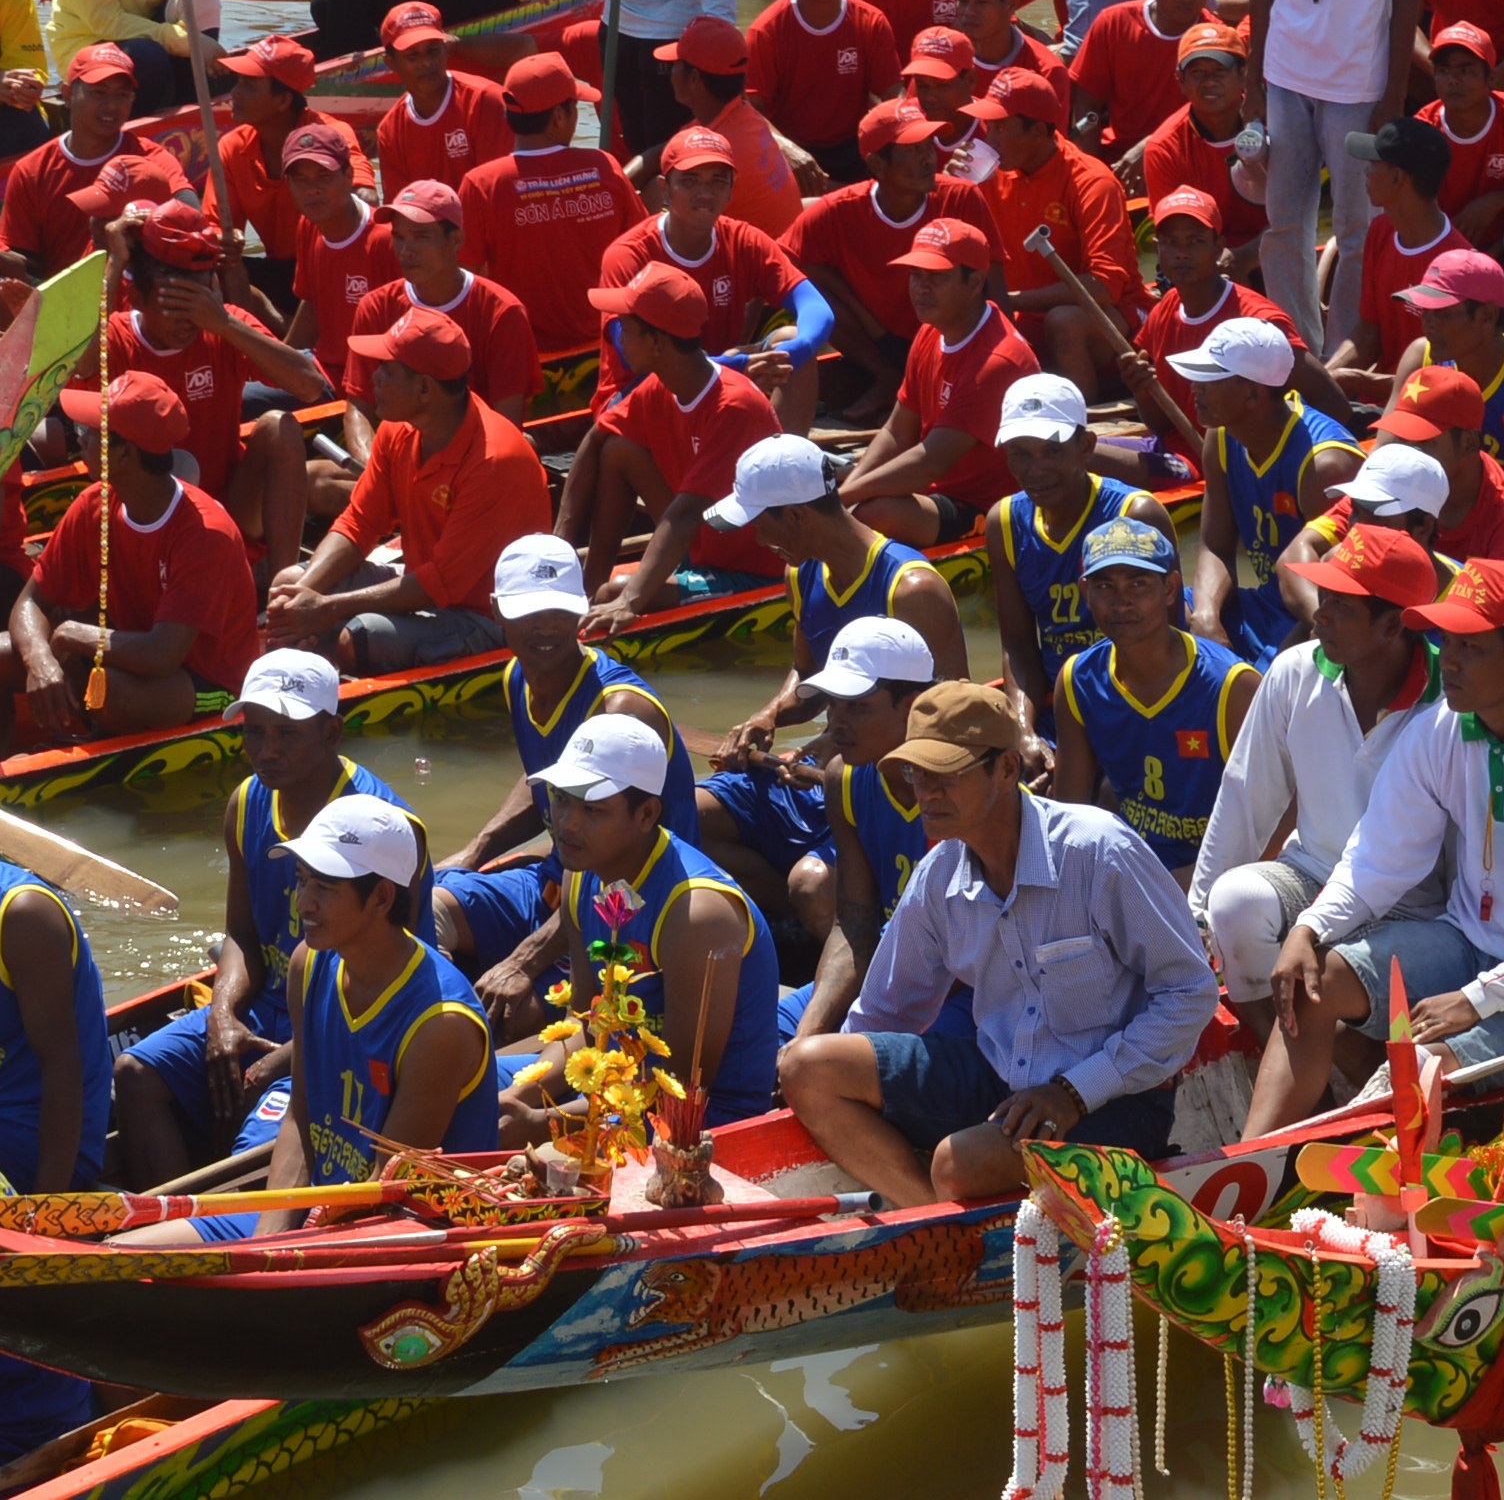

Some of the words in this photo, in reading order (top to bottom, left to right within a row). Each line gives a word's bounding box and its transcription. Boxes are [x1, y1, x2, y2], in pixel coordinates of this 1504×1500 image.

[514, 202, 551, 227] SƠN
[552, 196, 566, 220] Á
[565, 190, 614, 218] ĐÔNG
[1049, 582, 1081, 623] 22
[1144, 755, 1165, 801] 8
